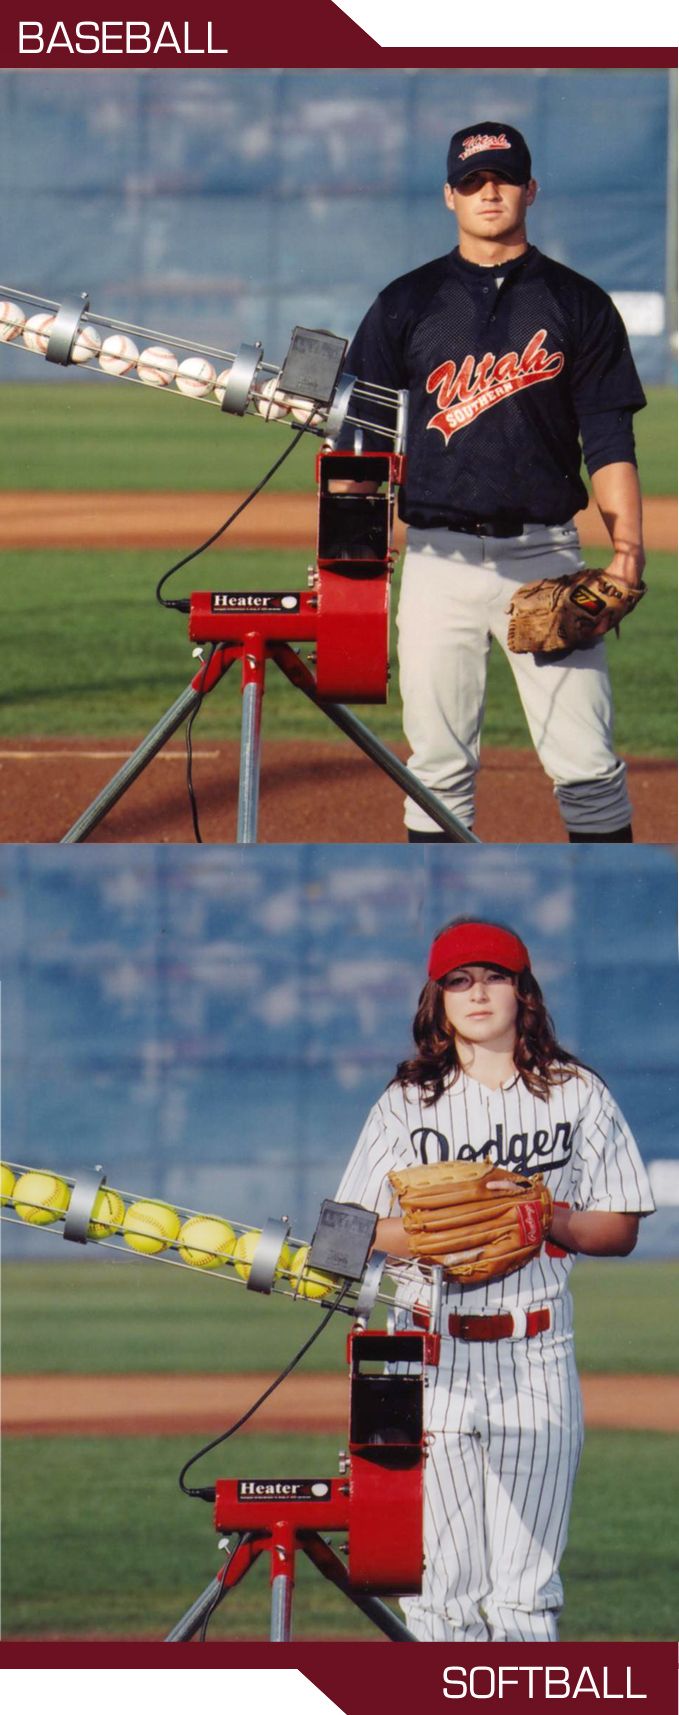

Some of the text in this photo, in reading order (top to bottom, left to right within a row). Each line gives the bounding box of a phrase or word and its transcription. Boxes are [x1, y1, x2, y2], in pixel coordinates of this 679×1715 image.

[426, 328, 564, 410] Utah
[445, 382, 514, 428] SOUTHERN
[214, 594, 272, 607] Heater
[410, 1122, 574, 1177] Dodger
[240, 1481, 301, 1495] Heater
